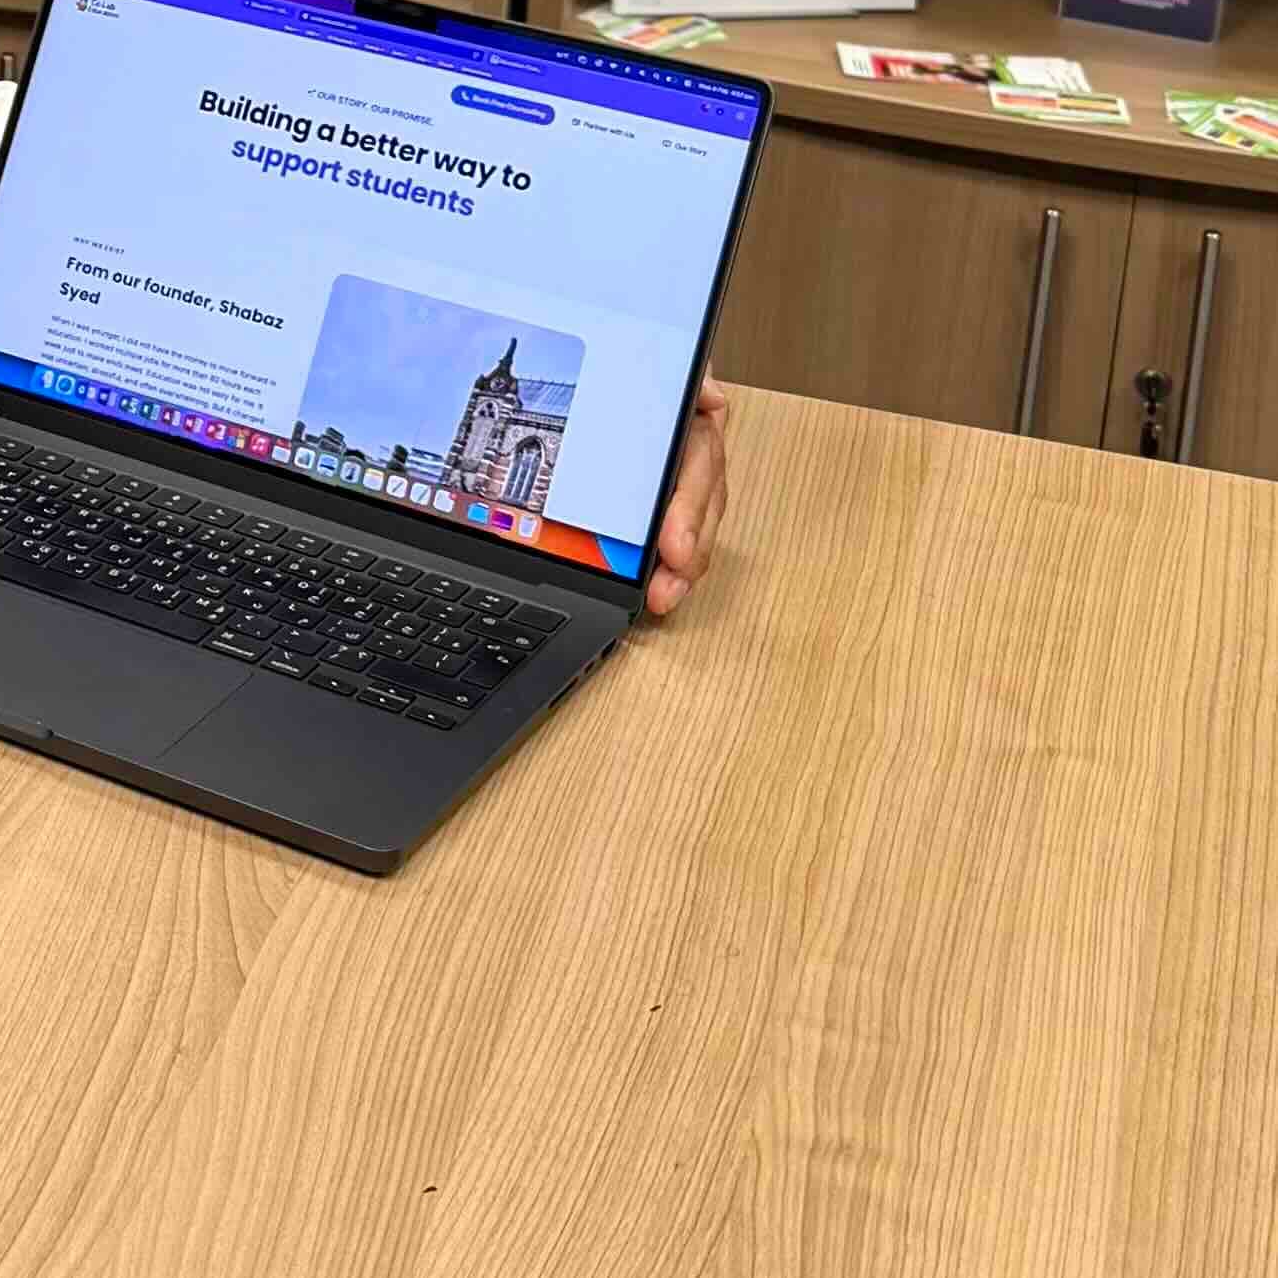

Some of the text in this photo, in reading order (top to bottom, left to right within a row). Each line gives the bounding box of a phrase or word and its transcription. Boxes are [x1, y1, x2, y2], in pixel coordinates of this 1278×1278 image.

[200, 91, 530, 190] Building a better way to
[232, 141, 477, 215] support students
[60, 283, 100, 304] Syed
[67, 257, 283, 329] From our founder, Shabaz
